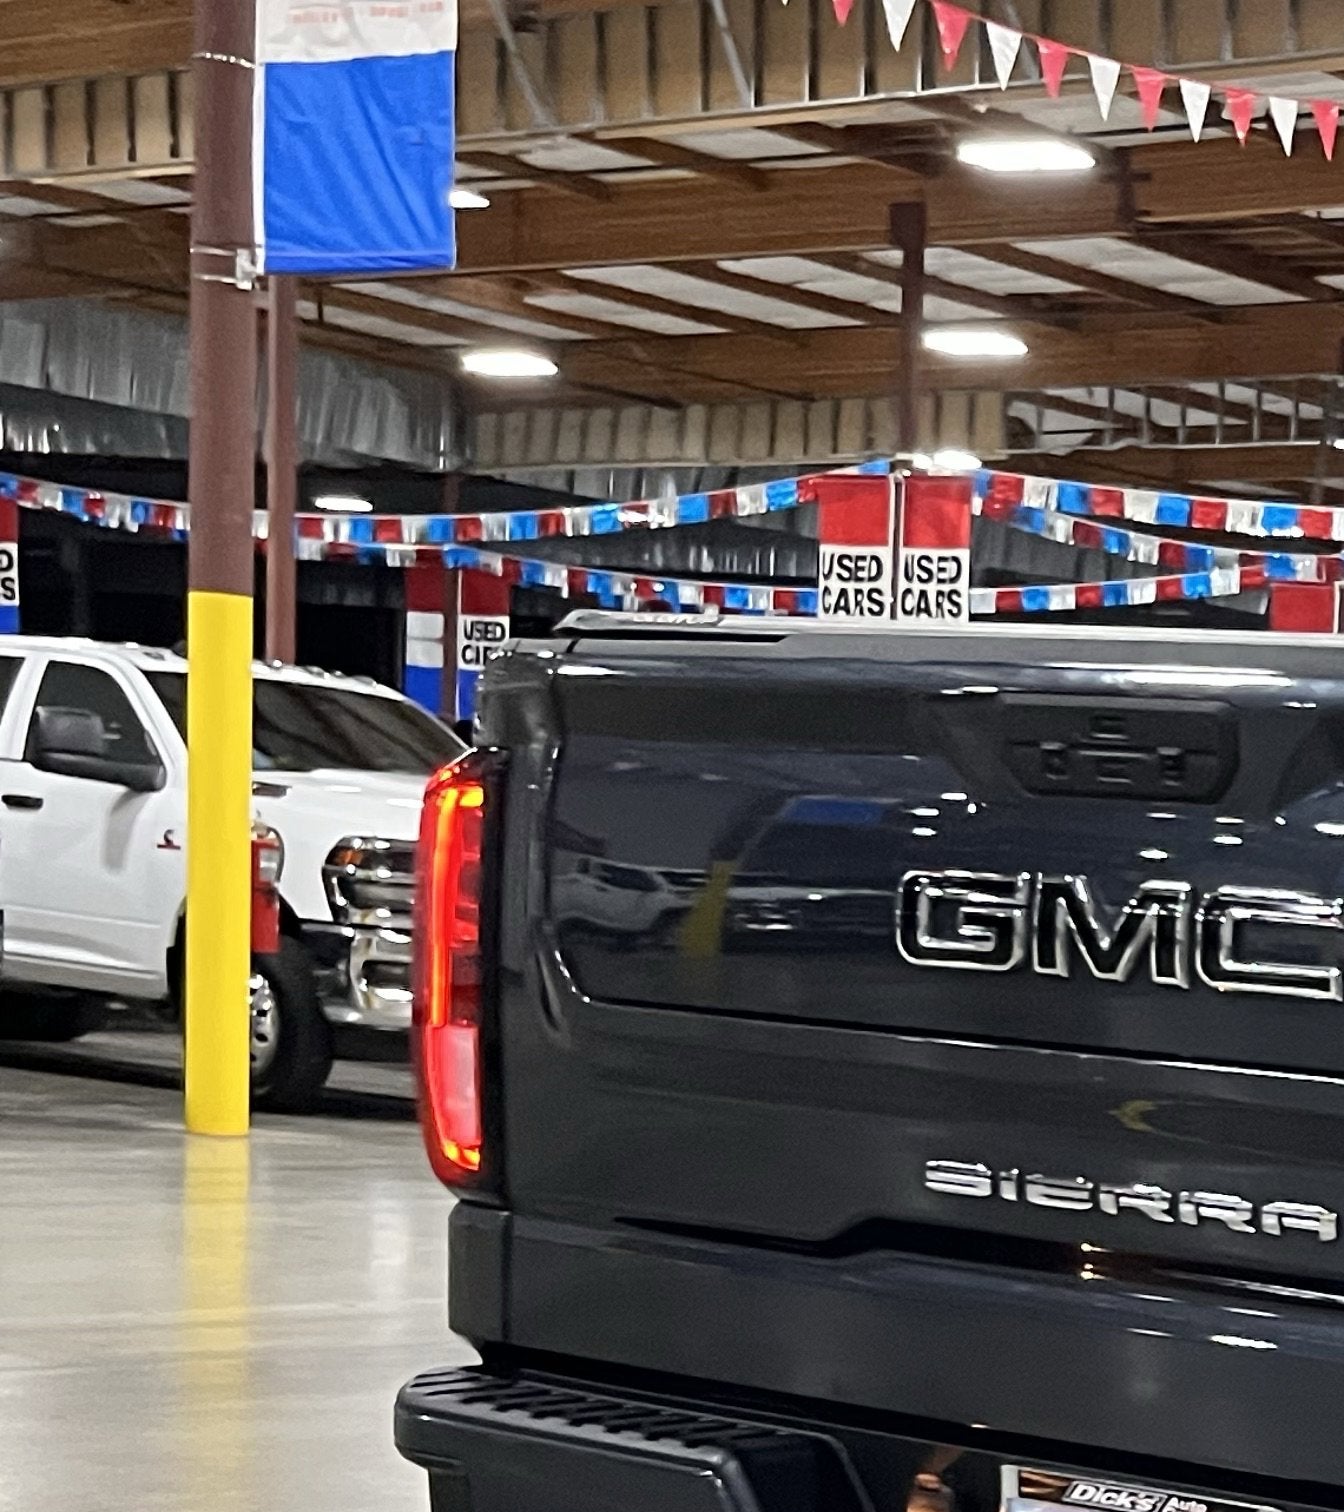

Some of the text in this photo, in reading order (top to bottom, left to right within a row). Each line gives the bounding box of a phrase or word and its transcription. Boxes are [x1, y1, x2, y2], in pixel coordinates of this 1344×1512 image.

[822, 552, 884, 583] USED
[904, 554, 962, 585] USED
[822, 586, 886, 617] CARS
[901, 588, 962, 619] CARS
[463, 620, 506, 643] USED
[924, 1159, 1339, 1242] SIERRA
